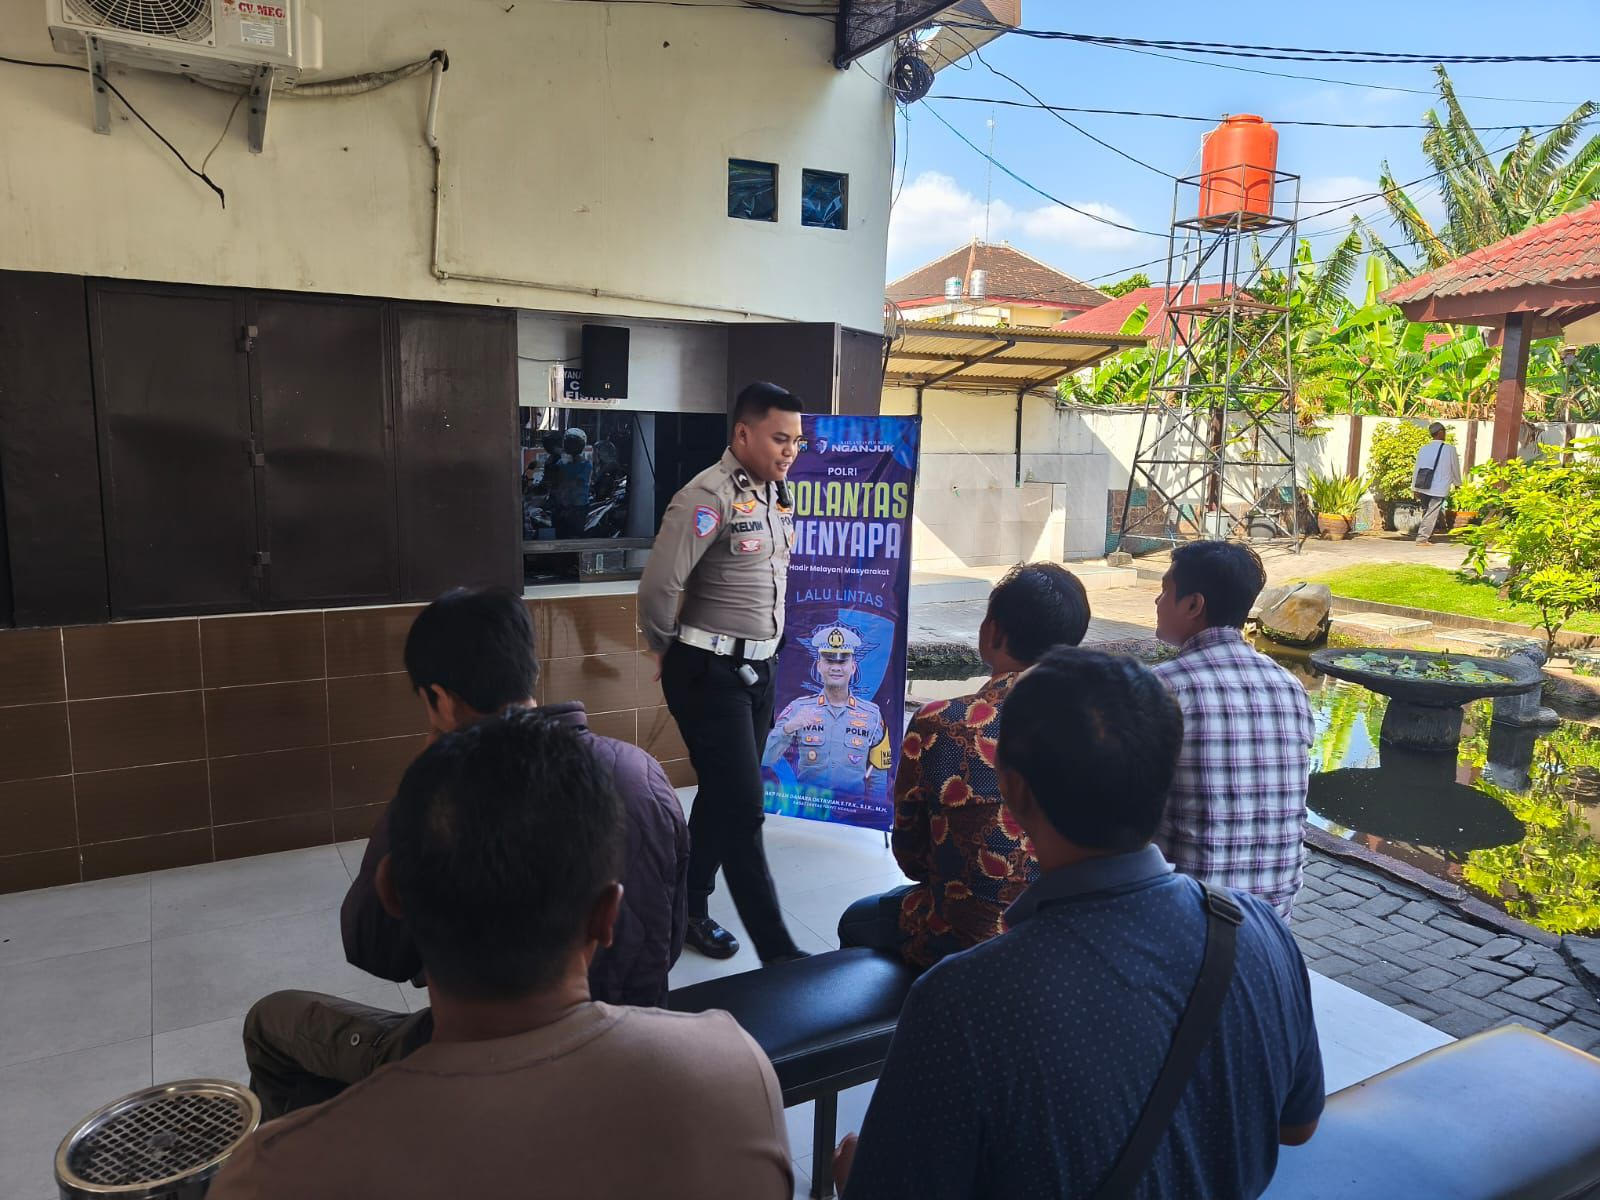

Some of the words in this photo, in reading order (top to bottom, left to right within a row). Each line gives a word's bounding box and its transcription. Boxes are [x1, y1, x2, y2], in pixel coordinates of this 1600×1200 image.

[831, 444, 895, 453] NGANJUK
[828, 467, 857, 476] POLRI
[732, 520, 764, 533] KELVIN
[790, 564, 809, 572] Hadir
[810, 566, 843, 574] Melayani
[845, 568, 890, 576] Masyarakat
[796, 589, 832, 603] LALU
[836, 590, 884, 608] LINTAS
[846, 728, 869, 737] POLRI
